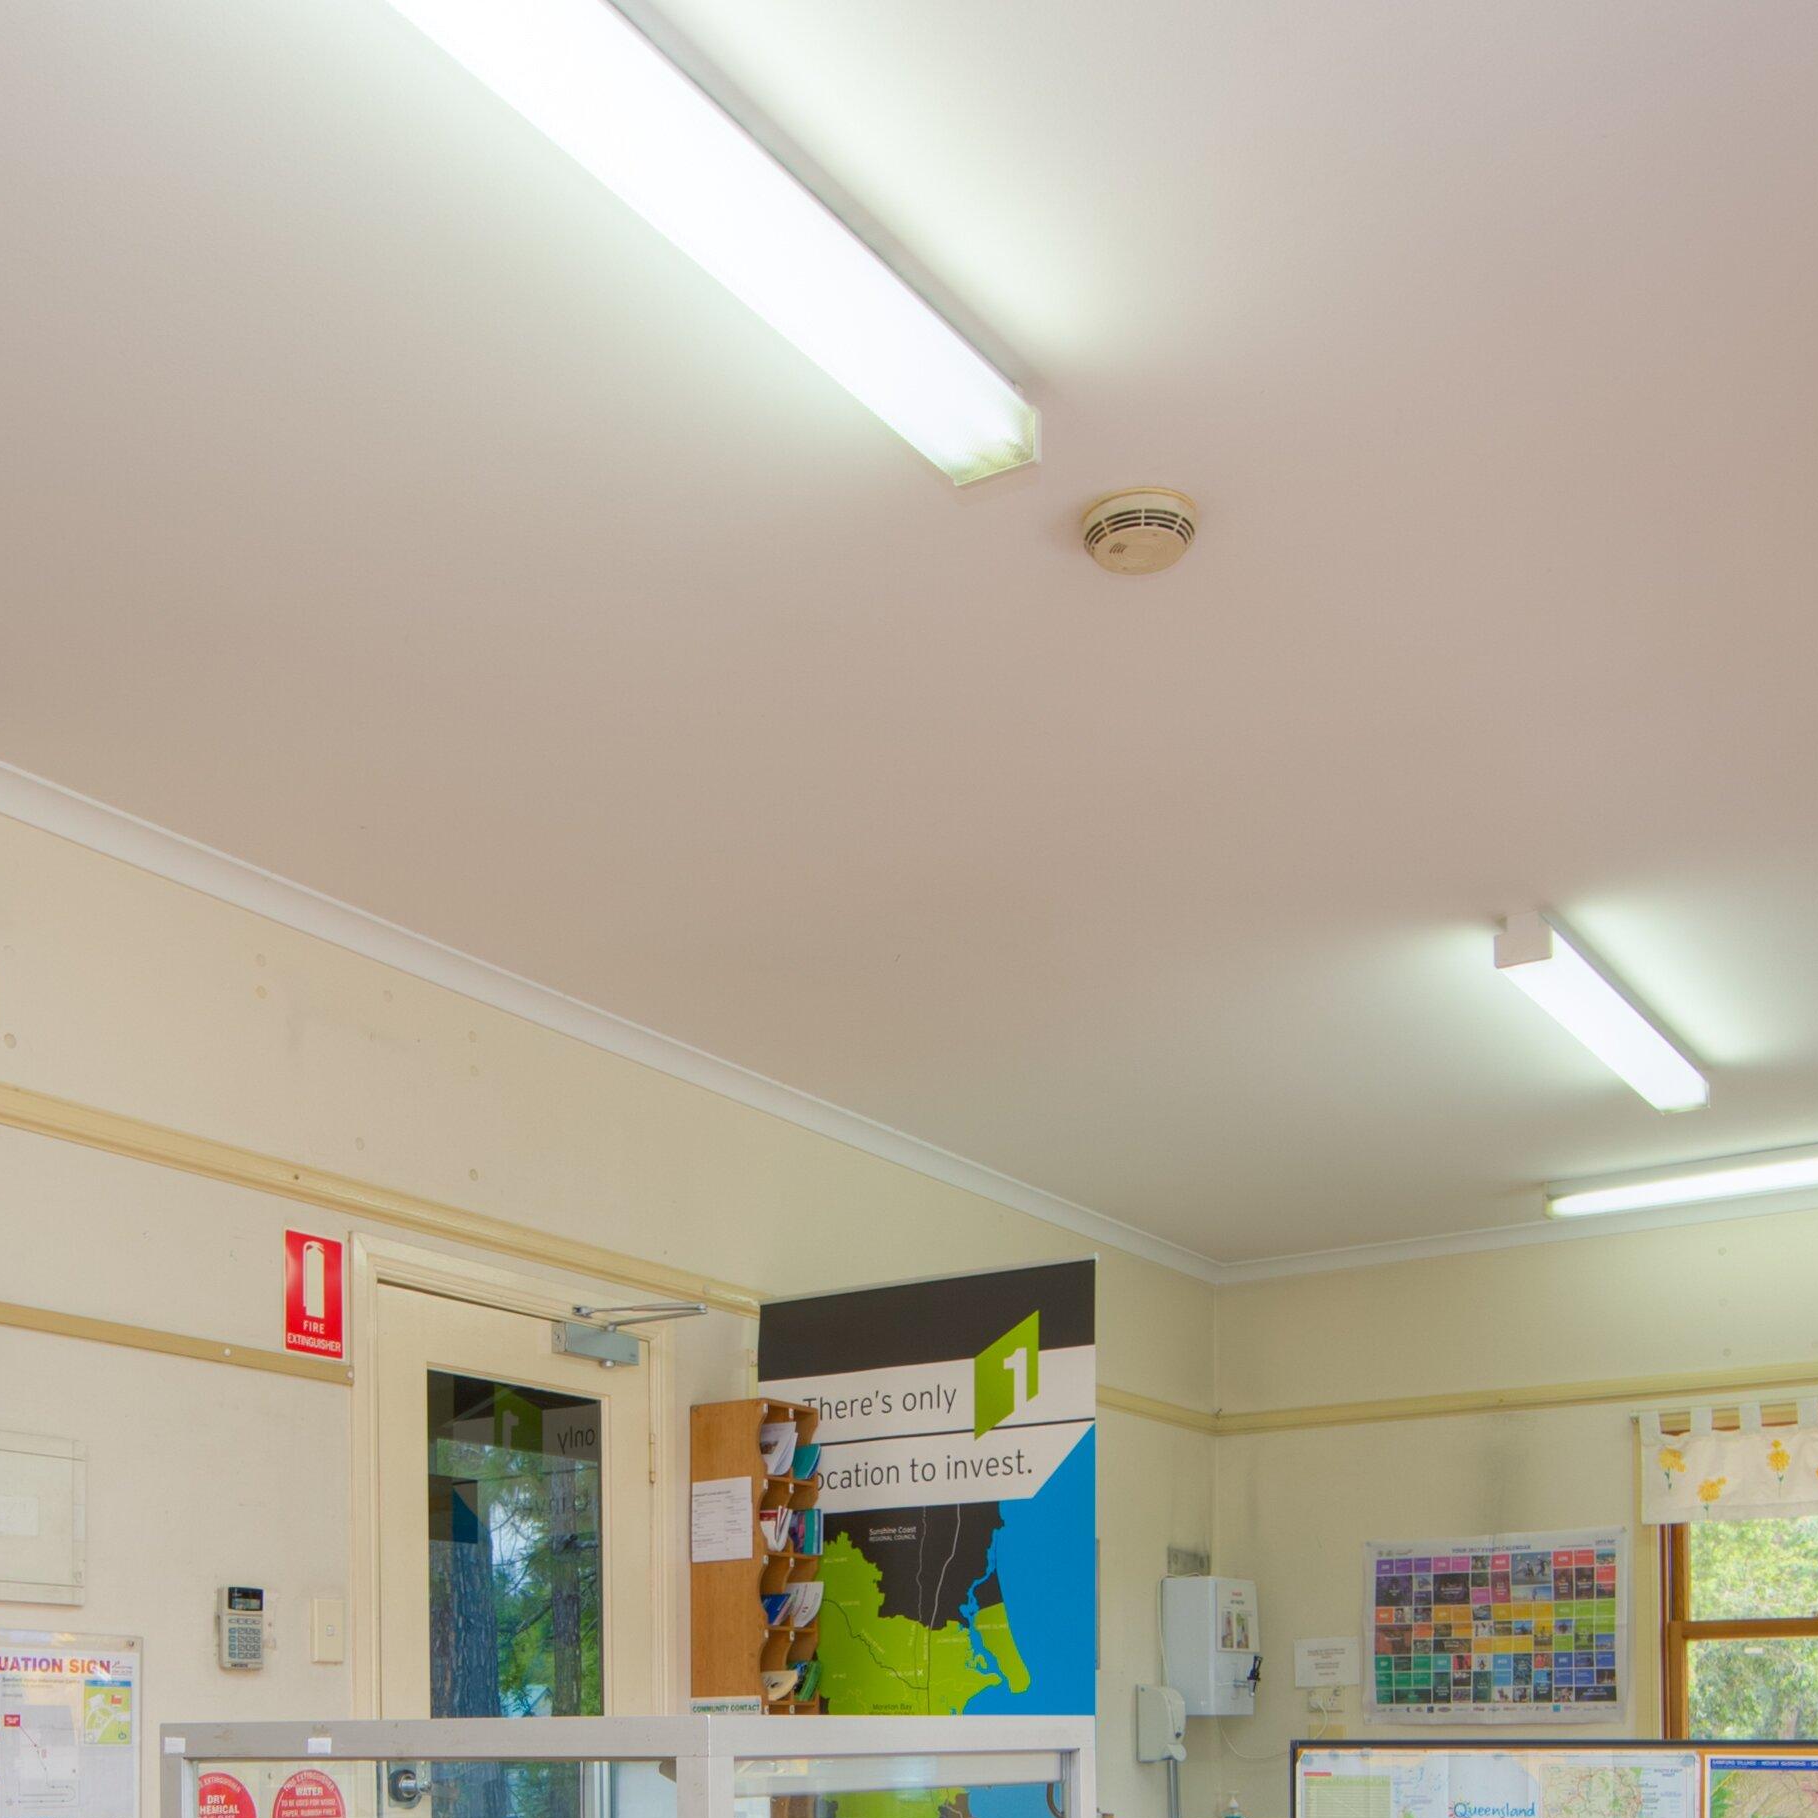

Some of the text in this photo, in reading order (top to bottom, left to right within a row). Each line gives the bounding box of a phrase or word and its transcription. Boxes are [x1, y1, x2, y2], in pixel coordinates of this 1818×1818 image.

[302, 1319, 326, 1334] FIRE
[287, 1332, 342, 1354] EXTINGUISHER
[803, 1347, 1029, 1422] There's only 1
[817, 1449, 1034, 1492] ocation to invest.
[900, 1525, 917, 1534] Coast
[68, 1658, 112, 1675] SIGN
[692, 1702, 761, 1714] COMMUNITY CONTACT
[872, 1703, 913, 1713] Moreton Bay
[295, 1786, 324, 1796] WATER
[207, 1795, 226, 1805] DRY
[199, 1805, 240, 1816] HEMICAL
[1454, 1802, 1536, 1818] Queensland
